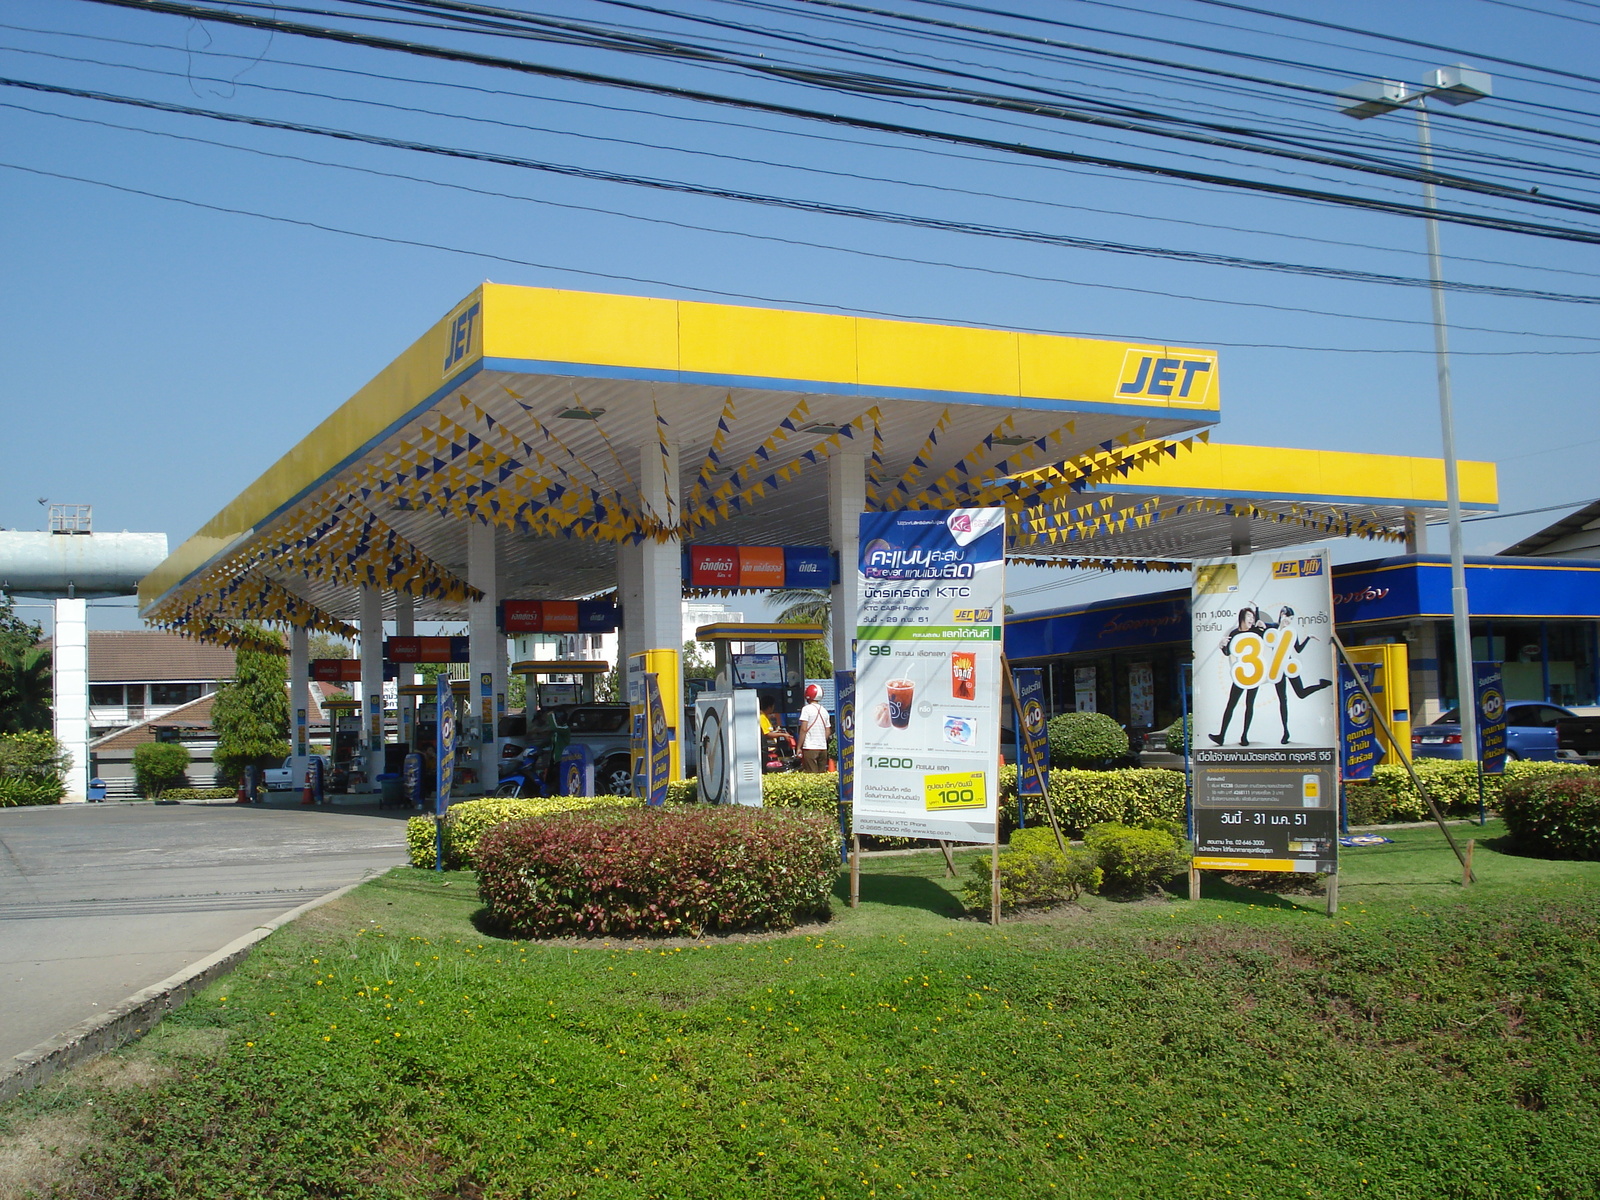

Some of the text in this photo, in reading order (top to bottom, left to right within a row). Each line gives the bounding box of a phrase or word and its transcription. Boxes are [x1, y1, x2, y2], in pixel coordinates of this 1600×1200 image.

[444, 302, 479, 371] JET
[1120, 357, 1210, 397] JET
[1275, 562, 1297, 573] JET
[1301, 559, 1321, 575] Jiffy
[864, 587, 971, 598] บัตรเครดิต KTC
[955, 610, 974, 619] JET
[1298, 611, 1329, 627] ทุกครั้ง
[869, 646, 891, 656] 99
[1235, 630, 1298, 686] 3%
[866, 756, 913, 769] 1,200
[938, 790, 974, 803] 100
[1220, 811, 1243, 825] วันนี้
[1253, 813, 1266, 825] 31
[1271, 815, 1291, 825] ม.ค.
[1294, 814, 1307, 825] 51
